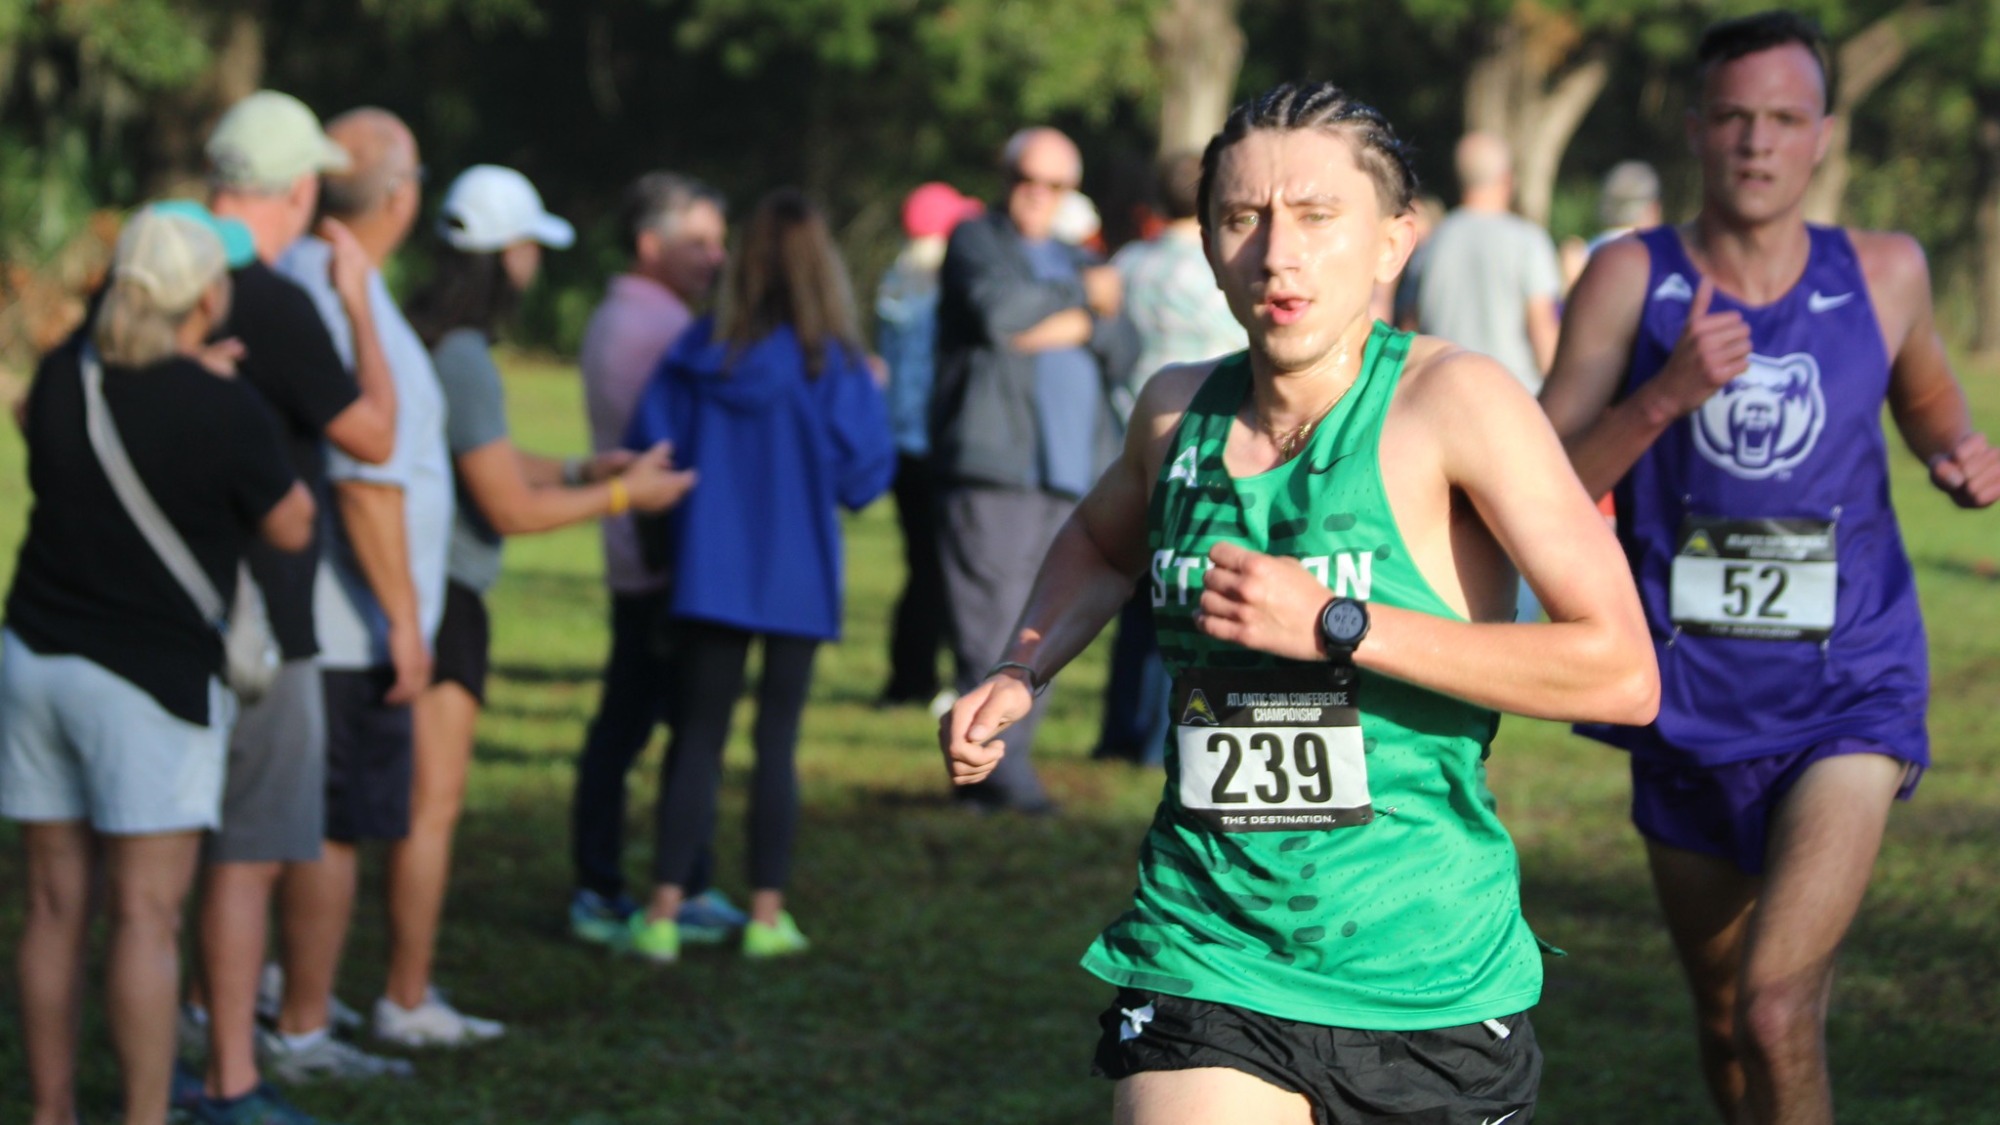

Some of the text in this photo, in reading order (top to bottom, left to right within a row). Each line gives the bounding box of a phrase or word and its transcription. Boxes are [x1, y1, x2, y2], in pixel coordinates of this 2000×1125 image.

[1723, 564, 1789, 619] 52
[1227, 691, 1349, 707] ATLANTIC SUN CONFERENCE
[1253, 707, 1322, 722] CHAMPIONSHIP
[1206, 732, 1333, 804] 239
[1221, 815, 1247, 825] THE
